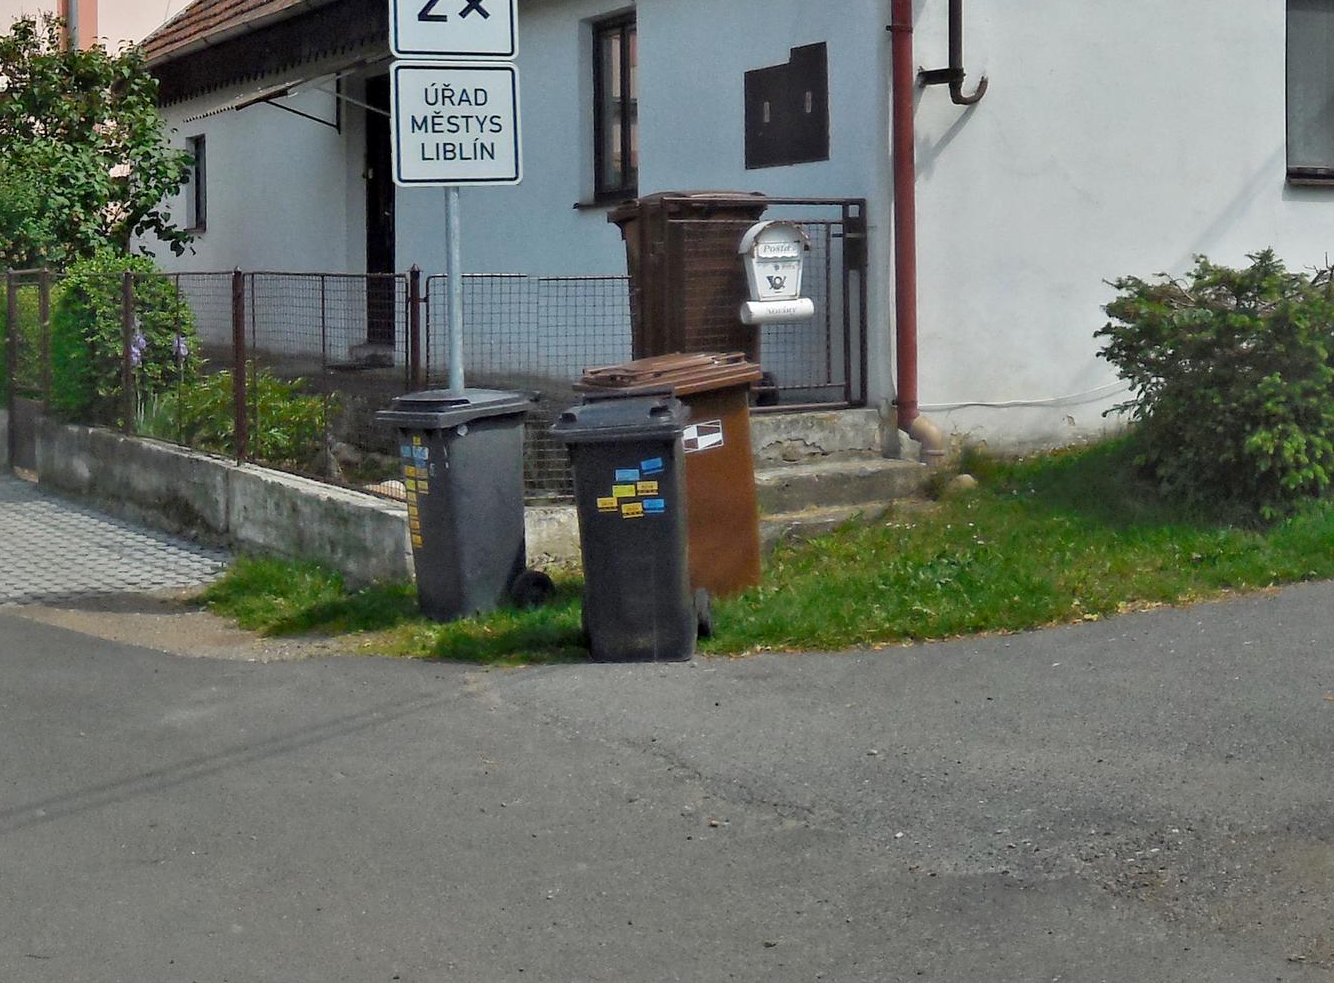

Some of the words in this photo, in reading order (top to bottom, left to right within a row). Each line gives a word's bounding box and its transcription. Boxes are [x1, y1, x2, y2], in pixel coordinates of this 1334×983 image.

[424, 82, 488, 106] ÚŘAD
[410, 110, 503, 134] MĚSTYS
[421, 137, 496, 161] LIBLÍN
